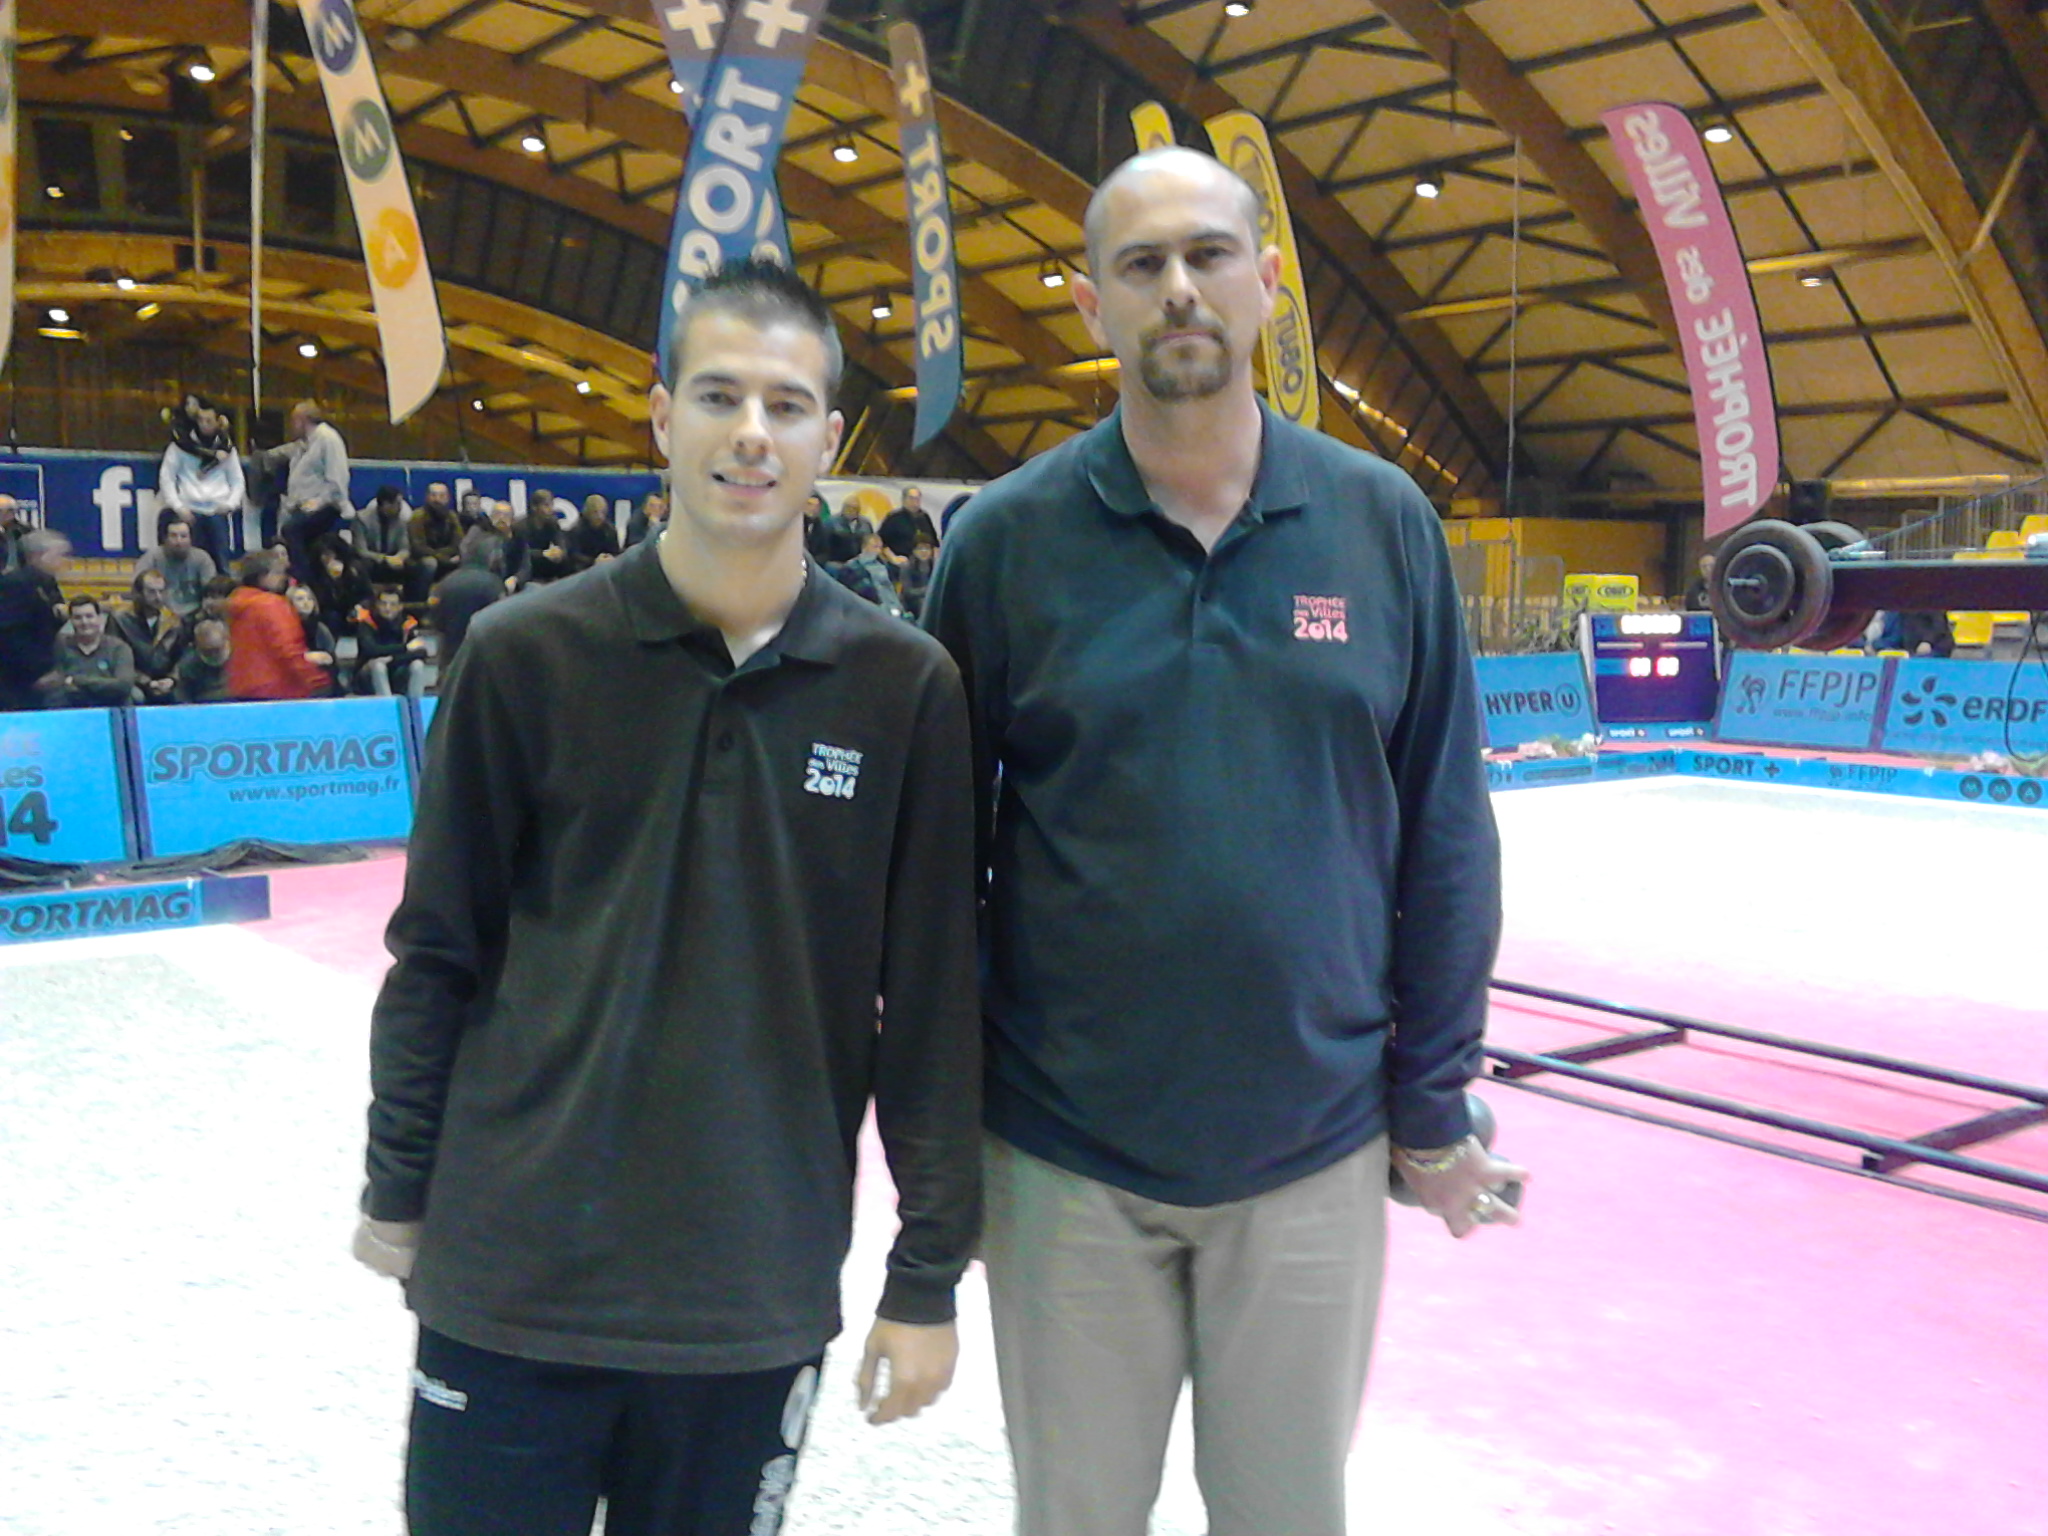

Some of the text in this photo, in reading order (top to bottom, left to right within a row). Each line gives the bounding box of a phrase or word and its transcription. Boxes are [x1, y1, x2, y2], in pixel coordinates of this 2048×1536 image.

[1294, 617, 1348, 643] 2014
[1485, 691, 1555, 715] HYPER
[1779, 669, 1877, 708] FFPJP
[152, 734, 396, 782] SPORTMAG
[1693, 754, 1755, 776] SPORT
[228, 776, 400, 804] www.sportmag.fr
[803, 767, 856, 800] 2014
[0, 892, 190, 934] PORTMAG
